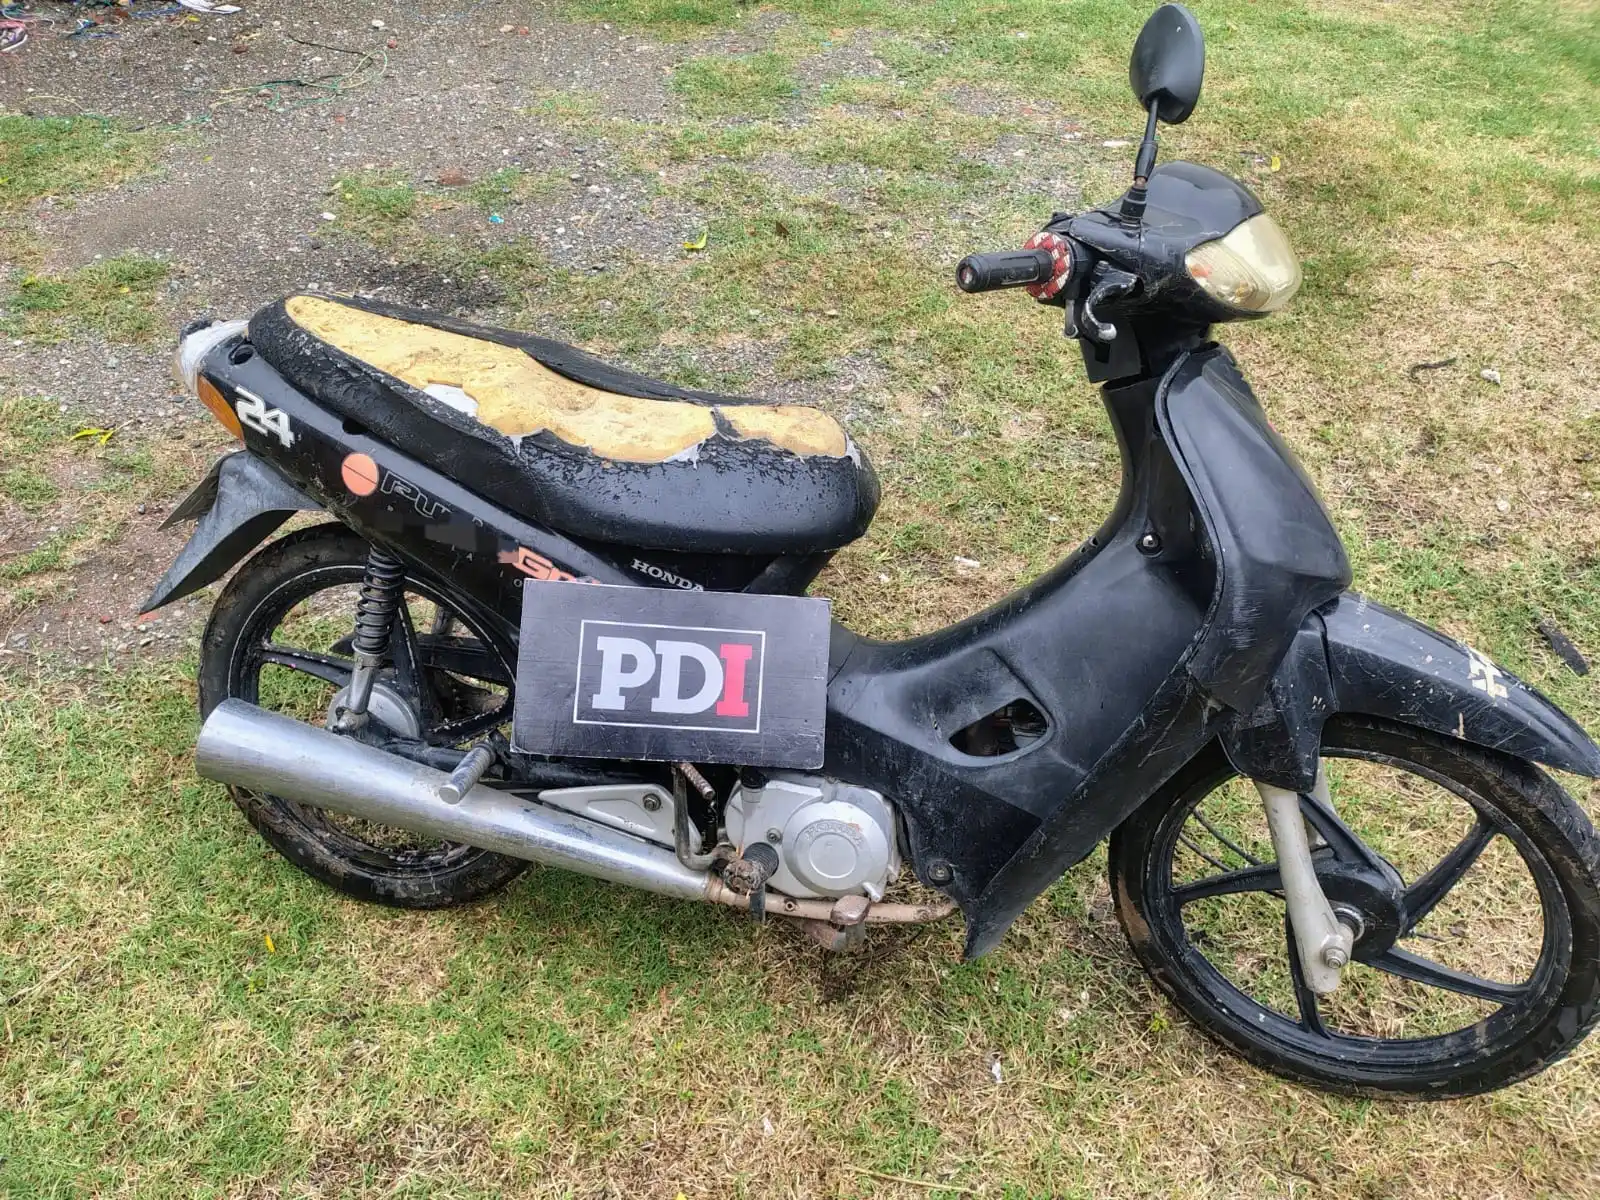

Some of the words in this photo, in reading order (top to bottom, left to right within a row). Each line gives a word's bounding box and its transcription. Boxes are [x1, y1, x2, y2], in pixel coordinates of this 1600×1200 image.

[233, 383, 295, 448] 24
[631, 558, 704, 592] HONDA
[592, 636, 753, 717] PDI
